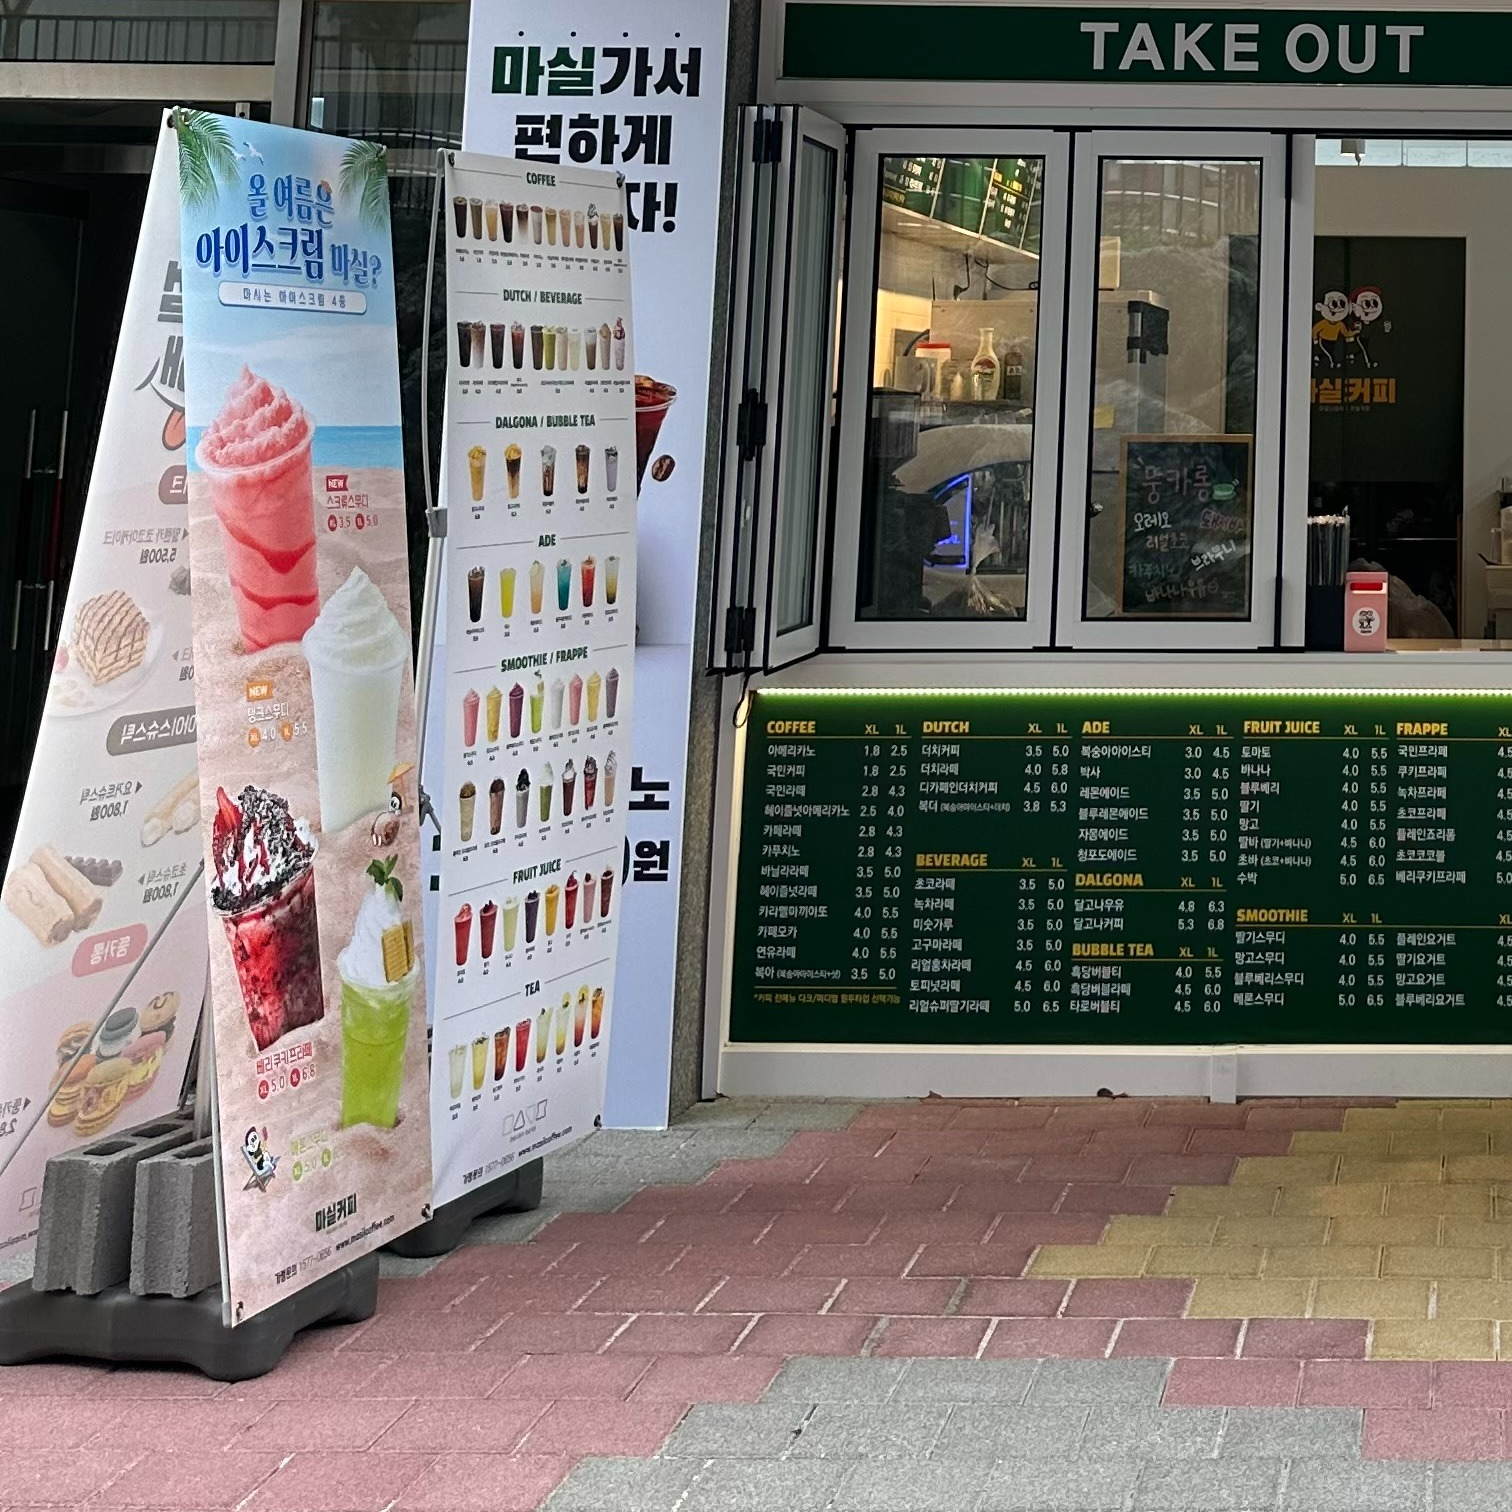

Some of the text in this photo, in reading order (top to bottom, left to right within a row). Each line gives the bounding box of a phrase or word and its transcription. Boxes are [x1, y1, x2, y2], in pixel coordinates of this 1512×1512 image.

[1081, 22, 1425, 74] TAKE OUT
[492, 46, 702, 97] 마실가서
[514, 113, 672, 165] 편하게
[526, 171, 556, 187] COFFEE
[248, 174, 334, 225] 올 여름은
[195, 224, 382, 286] 아이스크림 마실?
[503, 288, 583, 305] DUTCH BEVERAGE
[496, 414, 596, 430] DALGONA BUBBLE TEA
[1134, 512, 1172, 532] 오레오
[538, 534, 557, 547] ADE
[501, 646, 588, 673] SMOOTHIE FRAPPE
[767, 721, 906, 734] COFFEE XL 1L
[923, 721, 1042, 733] DUTCH XL
[1082, 721, 1109, 733] ADE
[1244, 721, 1320, 733] FRUIT JUICE
[1397, 723, 1448, 735] FRAPPE
[768, 745, 908, 757] 아메리카노 1.8 2.5
[922, 745, 1042, 757] 더치커피 3.5
[1081, 746, 1230, 759] 복숭아아이스티 3.0 4.5
[1242, 746, 1271, 758] 토마토
[1398, 745, 1447, 757] 국민프라페
[767, 765, 805, 777] 국민커피
[921, 763, 1041, 775] 더치라떼 4.0
[1241, 764, 1271, 776] 바나나
[1080, 787, 1130, 799] 레몬에이드
[1239, 819, 1259, 830] 망고
[762, 845, 800, 857] 카푸치노
[1078, 849, 1137, 862] 청포도에이드
[916, 854, 987, 866] BEVERAGE
[512, 858, 561, 884] FRUIT JUICE
[1076, 874, 1143, 886] DALGONA
[1237, 873, 1257, 885] 수박
[1074, 899, 1195, 912] 달고나우유 4.8
[1237, 909, 1308, 922] SMOOTHIE
[1074, 917, 1123, 930] 달고나커피
[912, 939, 962, 951] 고구마라떼
[1073, 944, 1153, 956] BUBBLE TEA
[1235, 952, 1284, 964] 망고스무디
[524, 981, 541, 997] TEA
[315, 1193, 357, 1232] 마실커피
